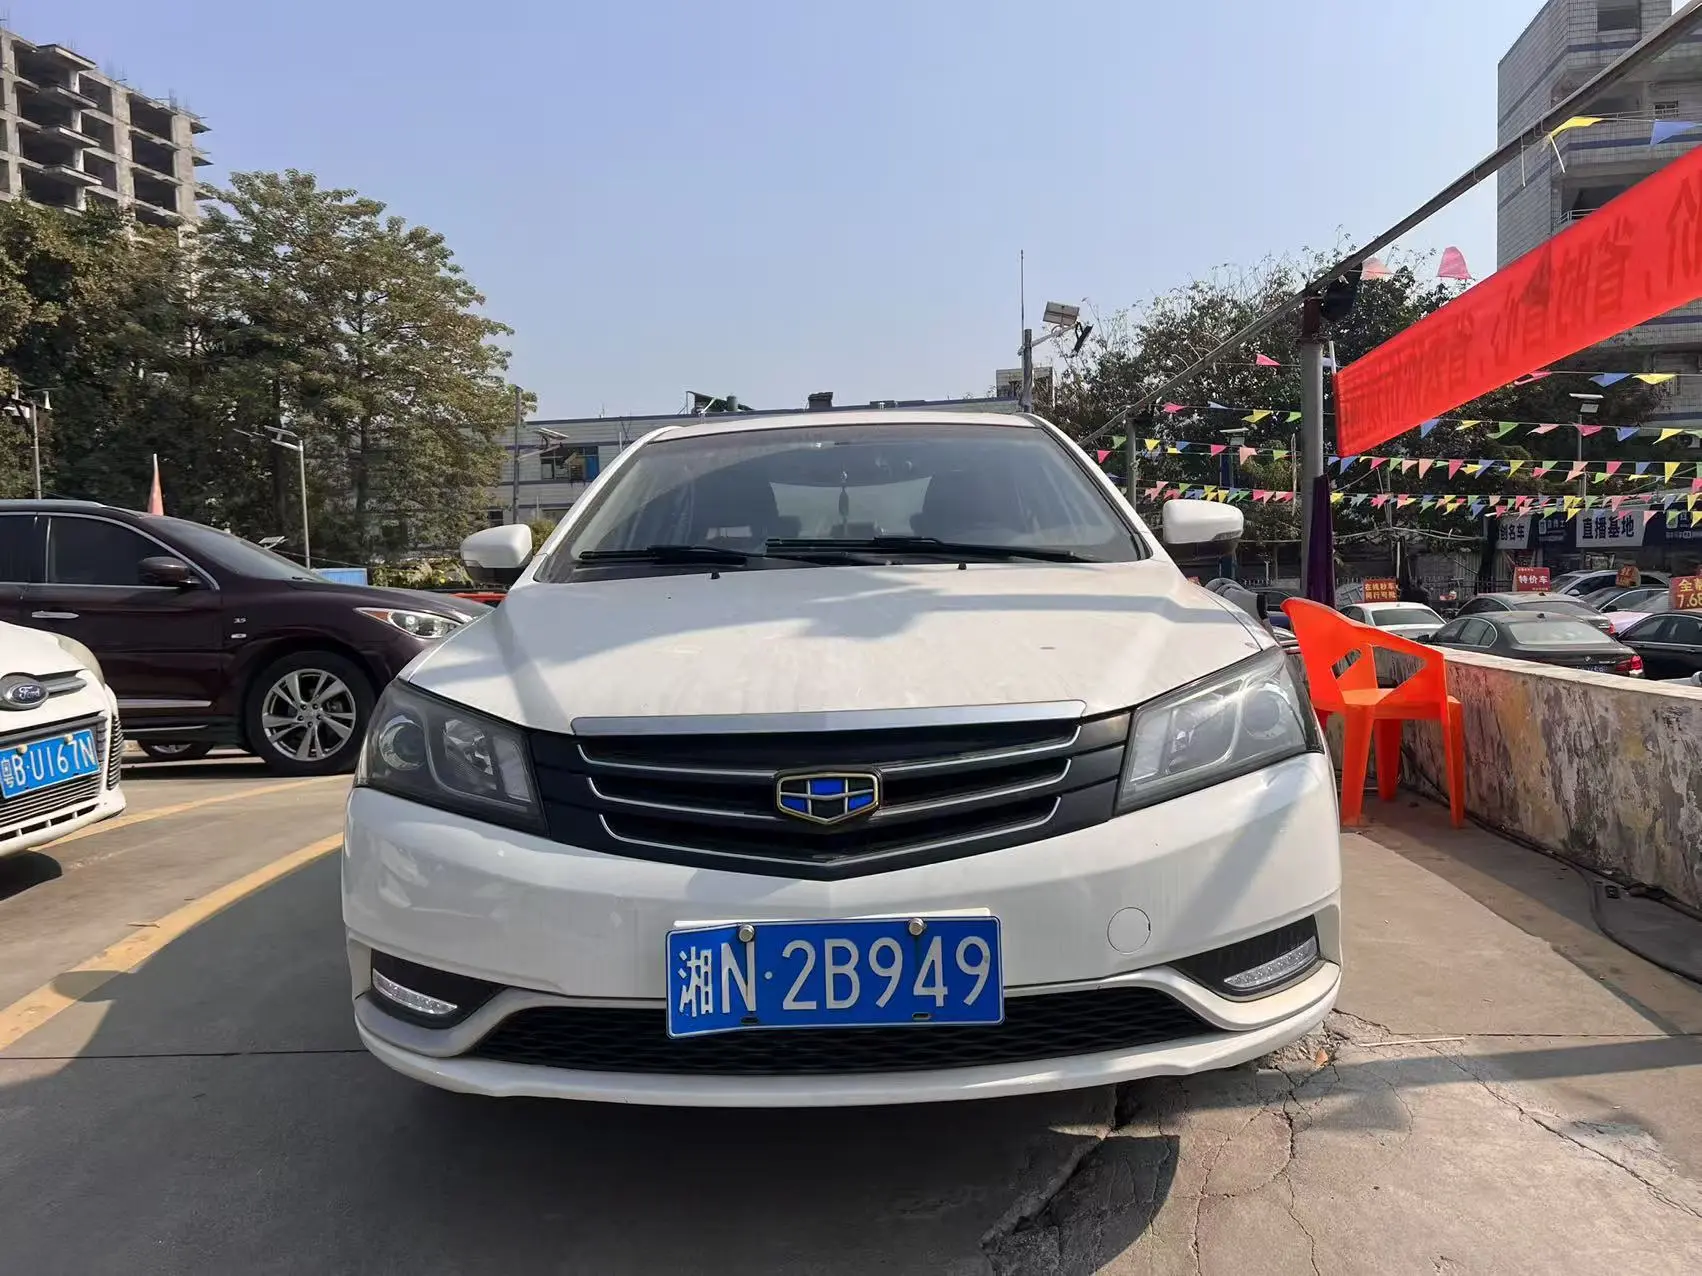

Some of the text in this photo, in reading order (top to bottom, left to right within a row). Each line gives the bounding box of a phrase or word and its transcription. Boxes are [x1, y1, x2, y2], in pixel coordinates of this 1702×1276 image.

[1582, 515, 1635, 539] 直播基地
[1518, 575, 1548, 584] 特价车
[18, 684, 41, 700] Ford
[678, 935, 991, 1017] 湘N·2B949
